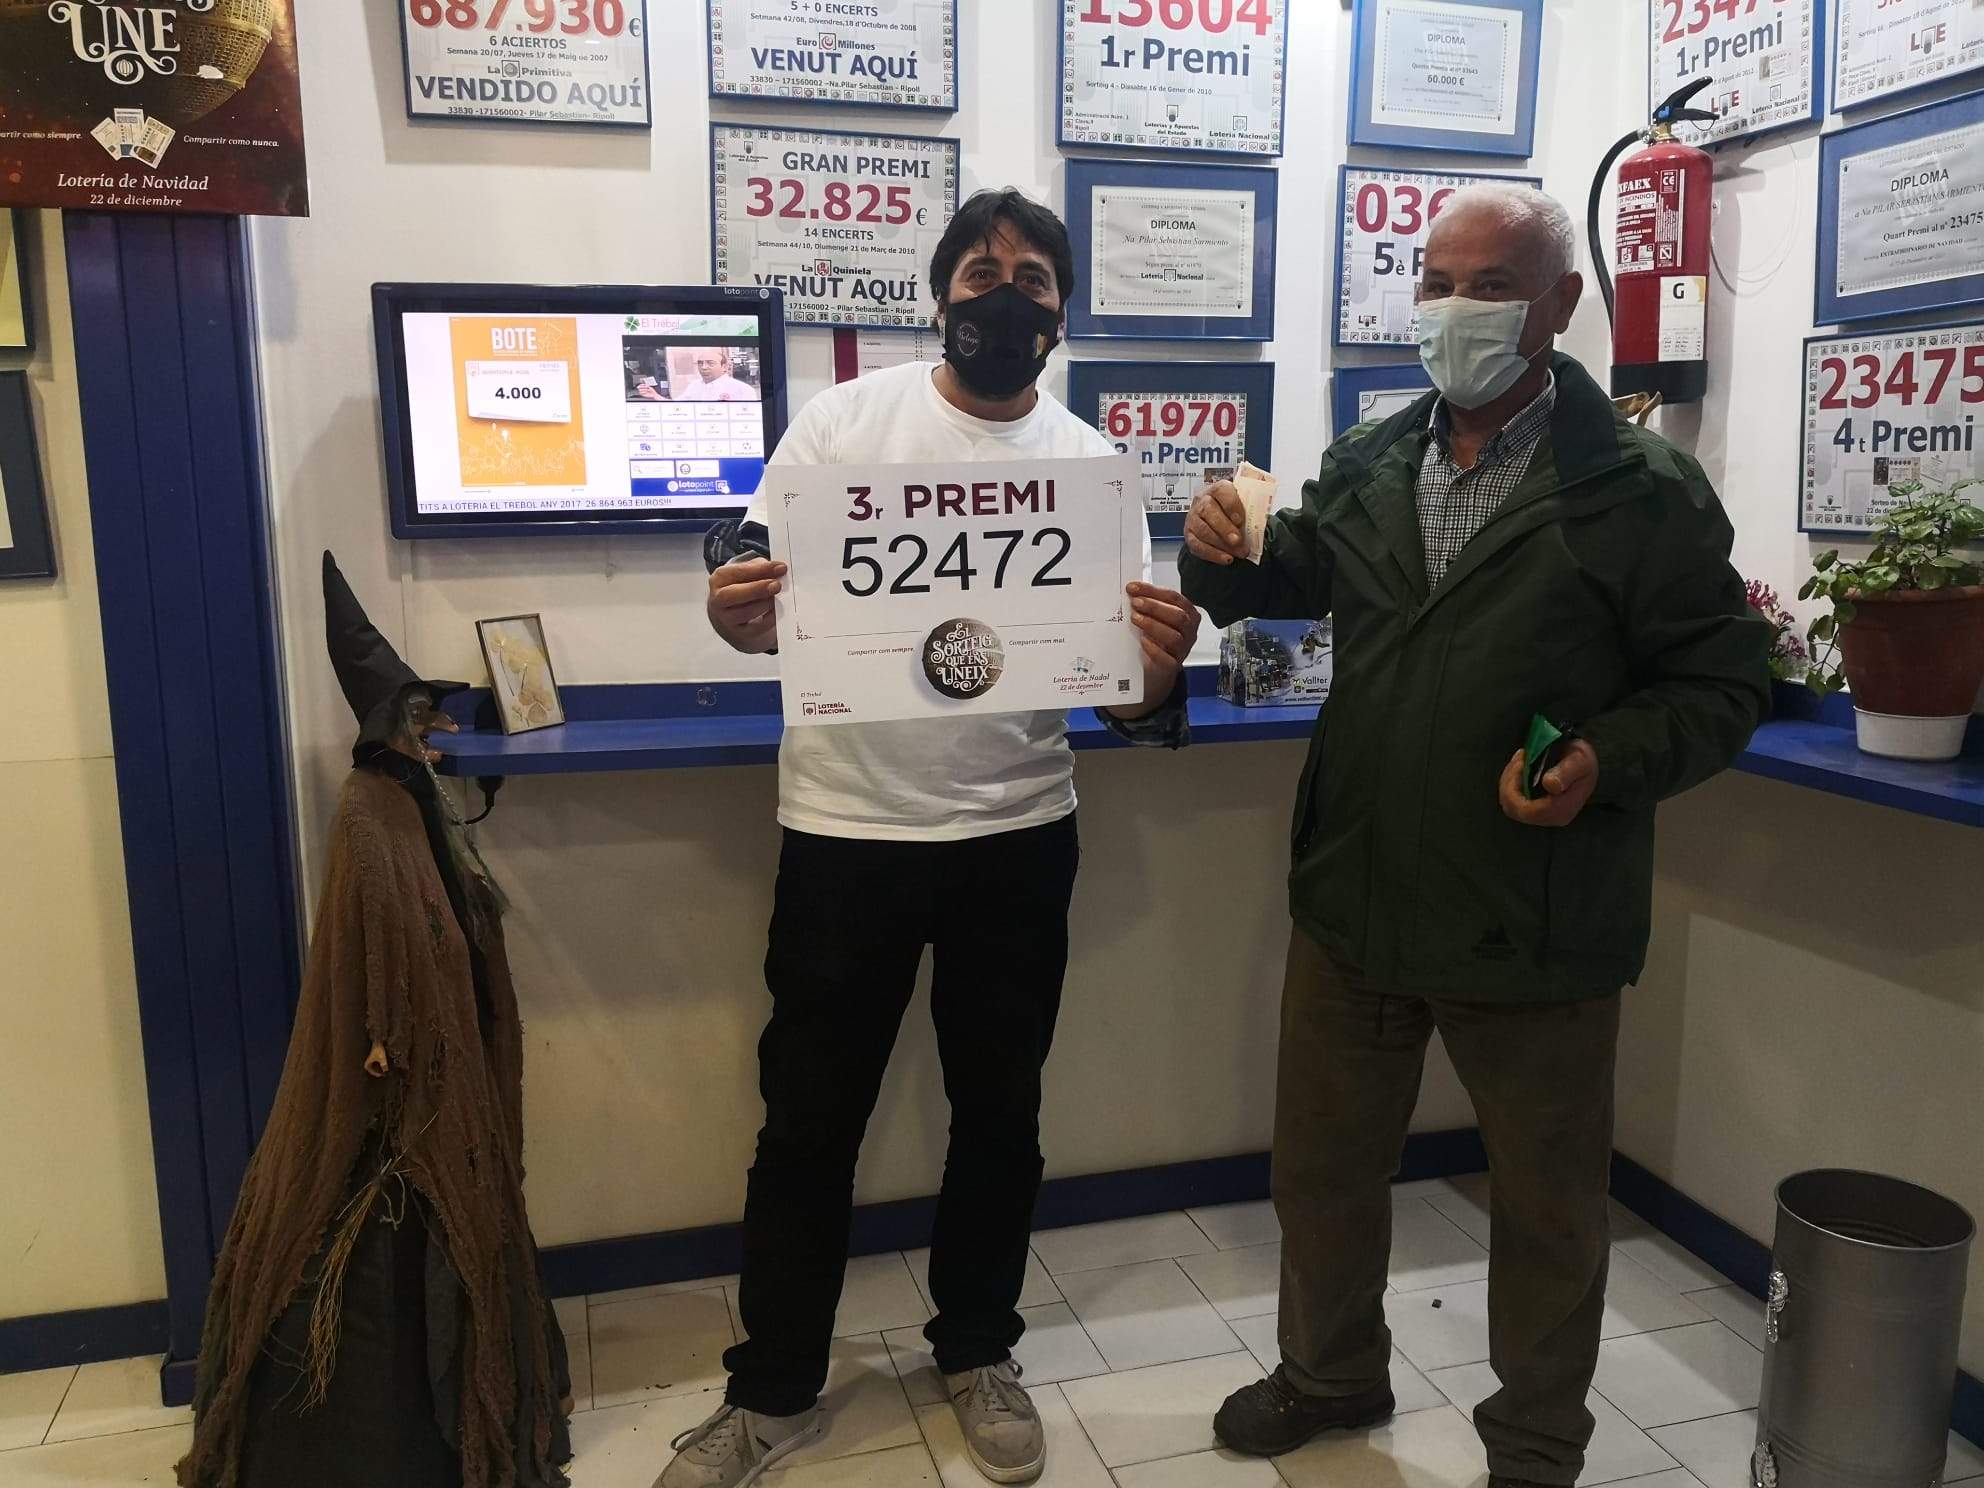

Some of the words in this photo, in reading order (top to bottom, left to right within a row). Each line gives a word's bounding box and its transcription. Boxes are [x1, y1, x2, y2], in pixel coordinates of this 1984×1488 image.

[791, 1, 797, 10] 5
[814, 4, 821, 12] 0
[826, 4, 878, 17] ENCERTS
[751, 13, 781, 22] Setmana
[783, 15, 807, 24] 42/08,
[856, 19, 888, 30] d'Octubre
[48, 7, 180, 84] UNE
[490, 35, 497, 46] 6
[501, 38, 567, 49] ACIERTOS
[796, 37, 817, 47] Euro
[838, 40, 875, 51] Millones
[1427, 33, 1466, 45] DIPLOMA
[1677, 47, 1699, 78] 1r
[1704, 12, 1782, 68] Premi
[447, 47, 478, 56] Semana
[508, 50, 534, 59] Jueves
[536, 51, 546, 59] 17
[558, 52, 577, 62] Maig
[590, 54, 608, 62] 2007
[1101, 35, 1135, 68] 1r
[1143, 38, 1250, 76] Premi
[487, 64, 500, 74] La
[522, 67, 572, 77] Primitiva
[751, 47, 842, 74] VENUT
[850, 50, 918, 83] AQUÍ
[750, 75, 773, 84] 33830
[782, 77, 823, 87] 171560002
[859, 82, 893, 92] Sebastian
[901, 85, 920, 93] Ripoll
[1427, 74, 1457, 85] 60.000
[416, 75, 558, 102] VENDIDO
[567, 77, 642, 111] AQUÍ
[1167, 86, 1186, 94] Gener
[1774, 95, 1800, 107] Nacional
[448, 106, 473, 115] 33830
[22, 131, 45, 139] como
[183, 135, 225, 147] Compartir
[252, 139, 280, 147] nunca.
[1238, 132, 1270, 140] Nacional
[783, 151, 848, 174] GRAN
[856, 157, 930, 179] PREMI
[57, 173, 114, 189] Lotería
[118, 173, 137, 188] de
[142, 175, 209, 191] Navidad
[1891, 168, 1950, 192] DIPLOMA
[90, 194, 104, 204] 22
[107, 194, 120, 205] de
[124, 195, 183, 207] diciembre
[1872, 202, 1895, 215] PILAR
[1896, 193, 1939, 209] SEBASTIAN
[1151, 219, 1196, 231] DIPLOMA
[1884, 232, 1906, 243] Quart
[1908, 225, 1930, 237] Premi
[1932, 222, 1938, 232] al
[1950, 211, 1983, 229] 23475
[804, 228, 818, 238] 14
[822, 229, 874, 241] ENCERTS
[1139, 235, 1157, 244] Pilar
[758, 240, 788, 248] Setmana
[789, 241, 813, 250] 44/10,
[815, 243, 848, 253] Diumenge
[851, 245, 859, 253] 21
[871, 245, 887, 255] Març
[888, 246, 897, 254] de
[899, 247, 915, 255] 2010
[1373, 242, 1405, 276] 5è
[802, 264, 813, 273] La
[833, 266, 872, 276] Quiniela
[1177, 273, 1204, 281] Nacional
[851, 274, 917, 306] AQUÍ
[1673, 283, 1684, 299] G
[789, 303, 829, 311] 171560002
[837, 304, 853, 312] Pilar
[855, 305, 889, 314] Sebastian
[896, 307, 915, 315] Ripoll
[491, 328, 537, 350] BOTE
[1819, 345, 1984, 410] 23475
[495, 387, 541, 400] 4.000
[1107, 401, 1237, 438] 61970
[1833, 417, 1866, 453] 4t
[1872, 415, 1974, 453] Premi
[1158, 441, 1230, 464] Premi
[679, 480, 714, 490] lotopoint
[450, 502, 487, 510] LOTERIA
[491, 502, 500, 510] EL
[504, 501, 537, 509] TREBOL
[540, 500, 558, 509] ANY
[561, 499, 581, 508] 2017
[847, 486, 884, 521] 3r
[904, 480, 1055, 518] PREMI
[842, 528, 1072, 597] 52472
[1009, 638, 1038, 646] Compartir
[848, 648, 877, 656] Compartir
[892, 646, 914, 654] sempre
[946, 655, 966, 668] QUE
[968, 651, 989, 666] ENS
[936, 665, 993, 692] UNEIX
[1079, 674, 1087, 682] de
[1089, 672, 1110, 682] Nadal
[818, 707, 853, 715] NACIONAL
